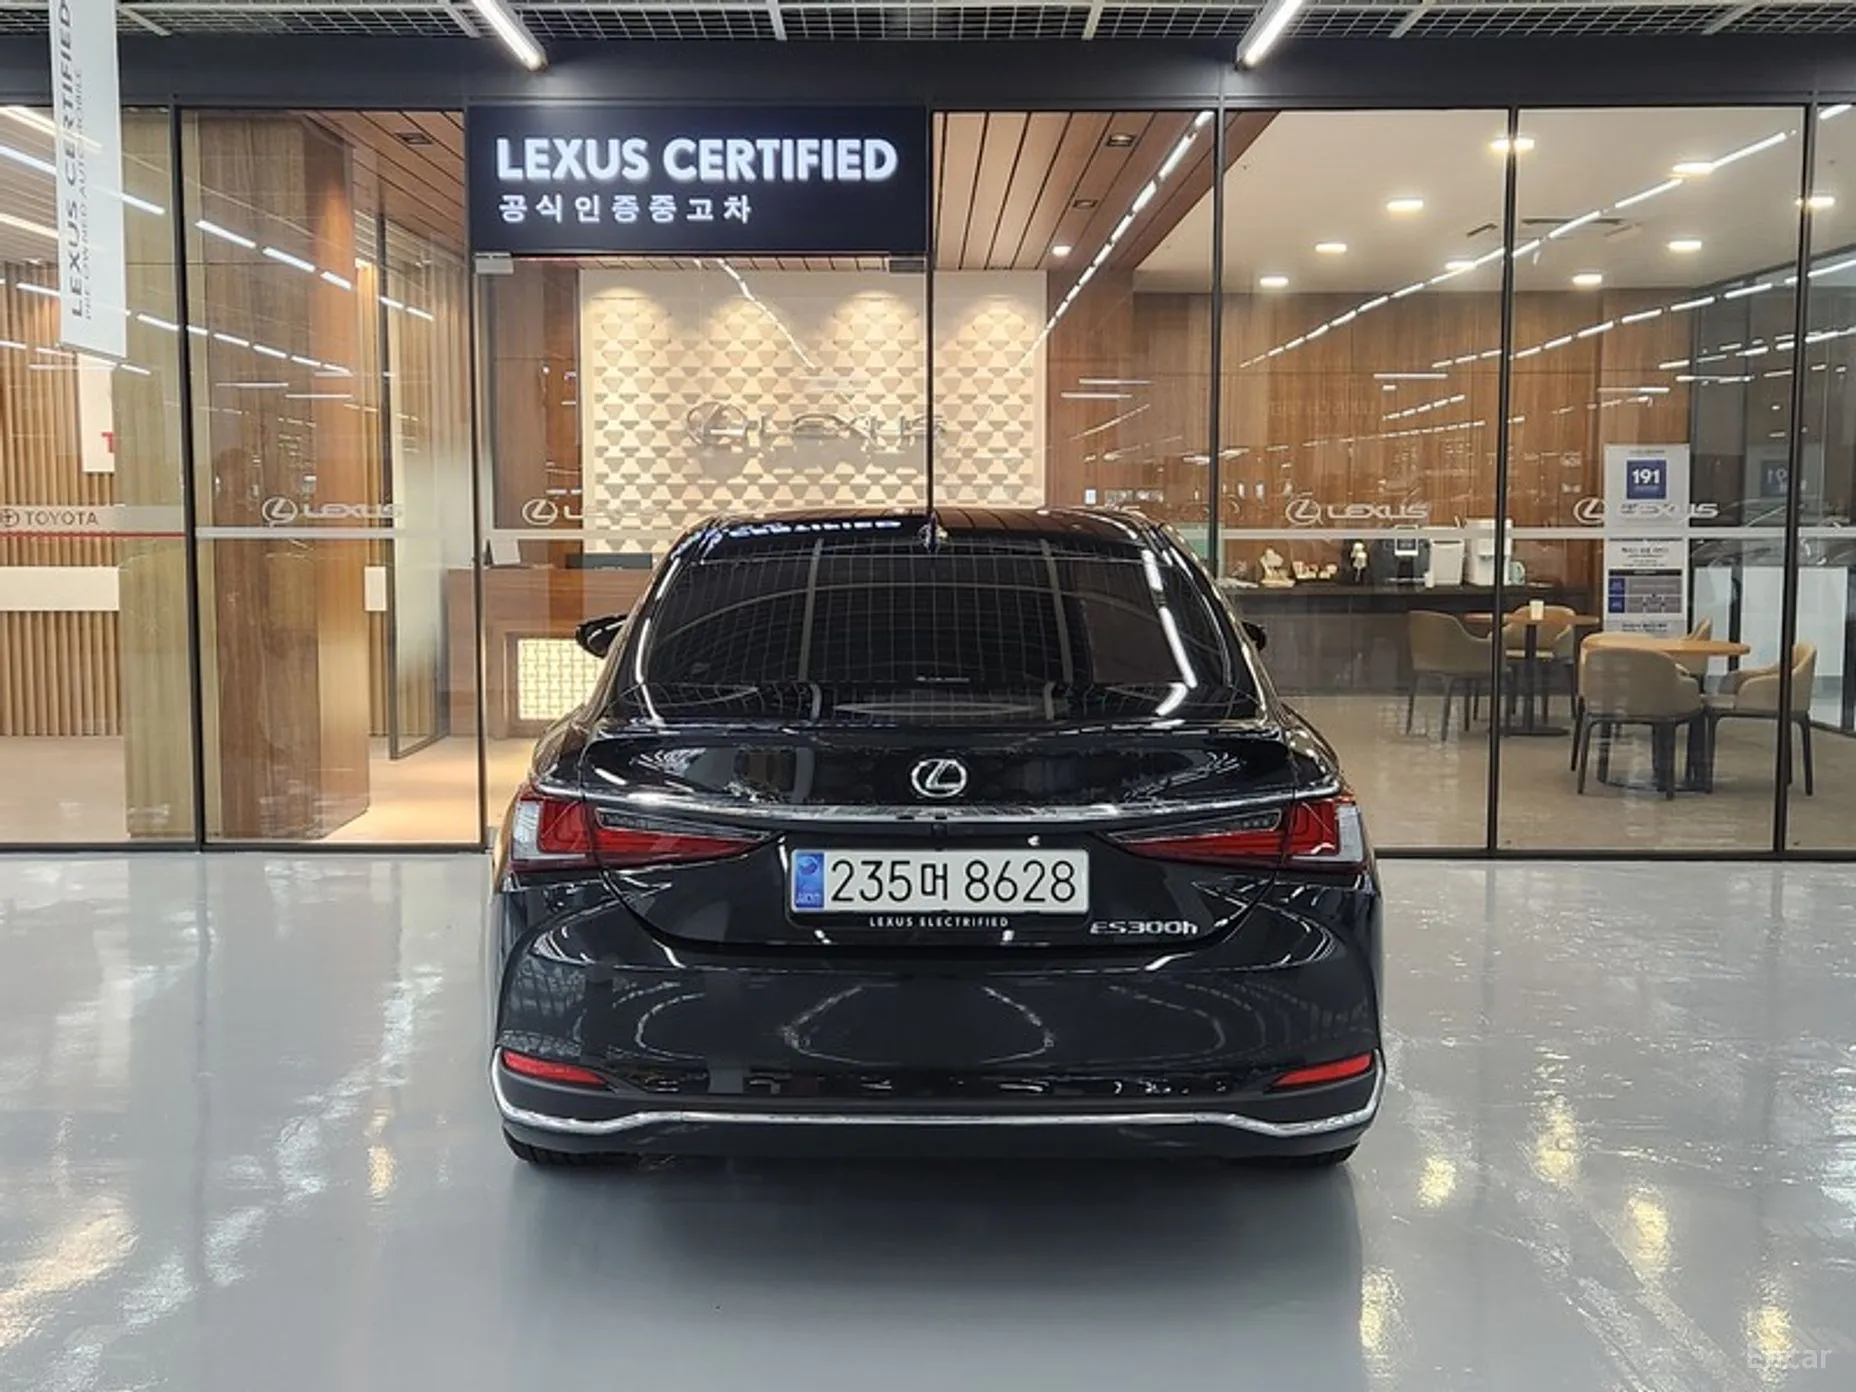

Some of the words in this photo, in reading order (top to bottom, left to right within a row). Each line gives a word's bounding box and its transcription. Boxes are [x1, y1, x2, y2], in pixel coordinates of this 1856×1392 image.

[497, 138, 649, 181] LEXUS
[662, 138, 898, 181] CERTIFIED
[65, 201, 83, 317] LEXUS
[1632, 468, 1661, 484] 191
[25, 510, 99, 525] TOYOTA
[304, 503, 405, 518] LEXUS
[1327, 503, 1429, 519] LEXUS
[965, 859, 1075, 902] 8628
[869, 916, 913, 928] LEXUS
[919, 916, 1009, 928] ELECTRIFIED
[1090, 921, 1198, 935] ES300h
